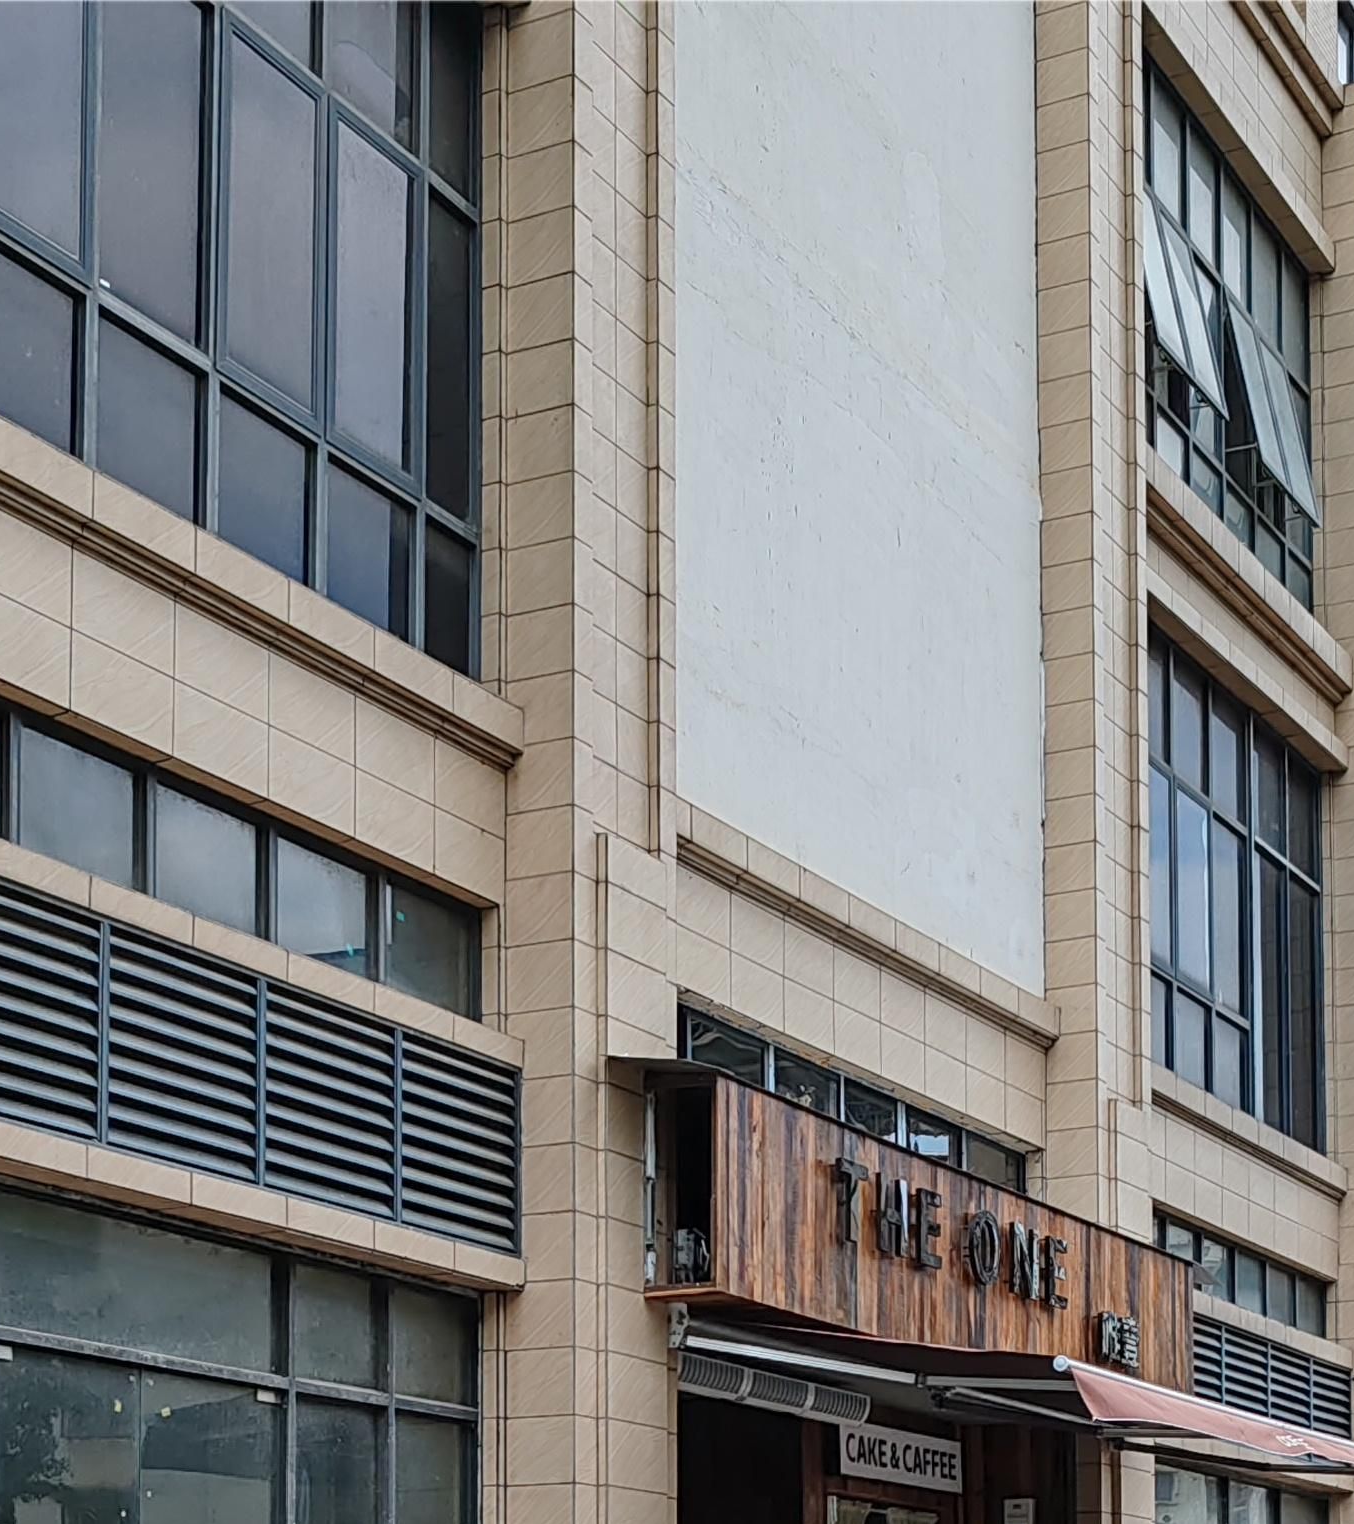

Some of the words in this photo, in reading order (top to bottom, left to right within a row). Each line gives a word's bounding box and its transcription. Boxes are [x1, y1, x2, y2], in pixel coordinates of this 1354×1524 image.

[834, 1157, 943, 1270] THE
[968, 1209, 1069, 1310] ONE
[846, 1432, 888, 1468] CAKE
[890, 1442, 900, 1470] &
[902, 1443, 957, 1481] CAFFEE
